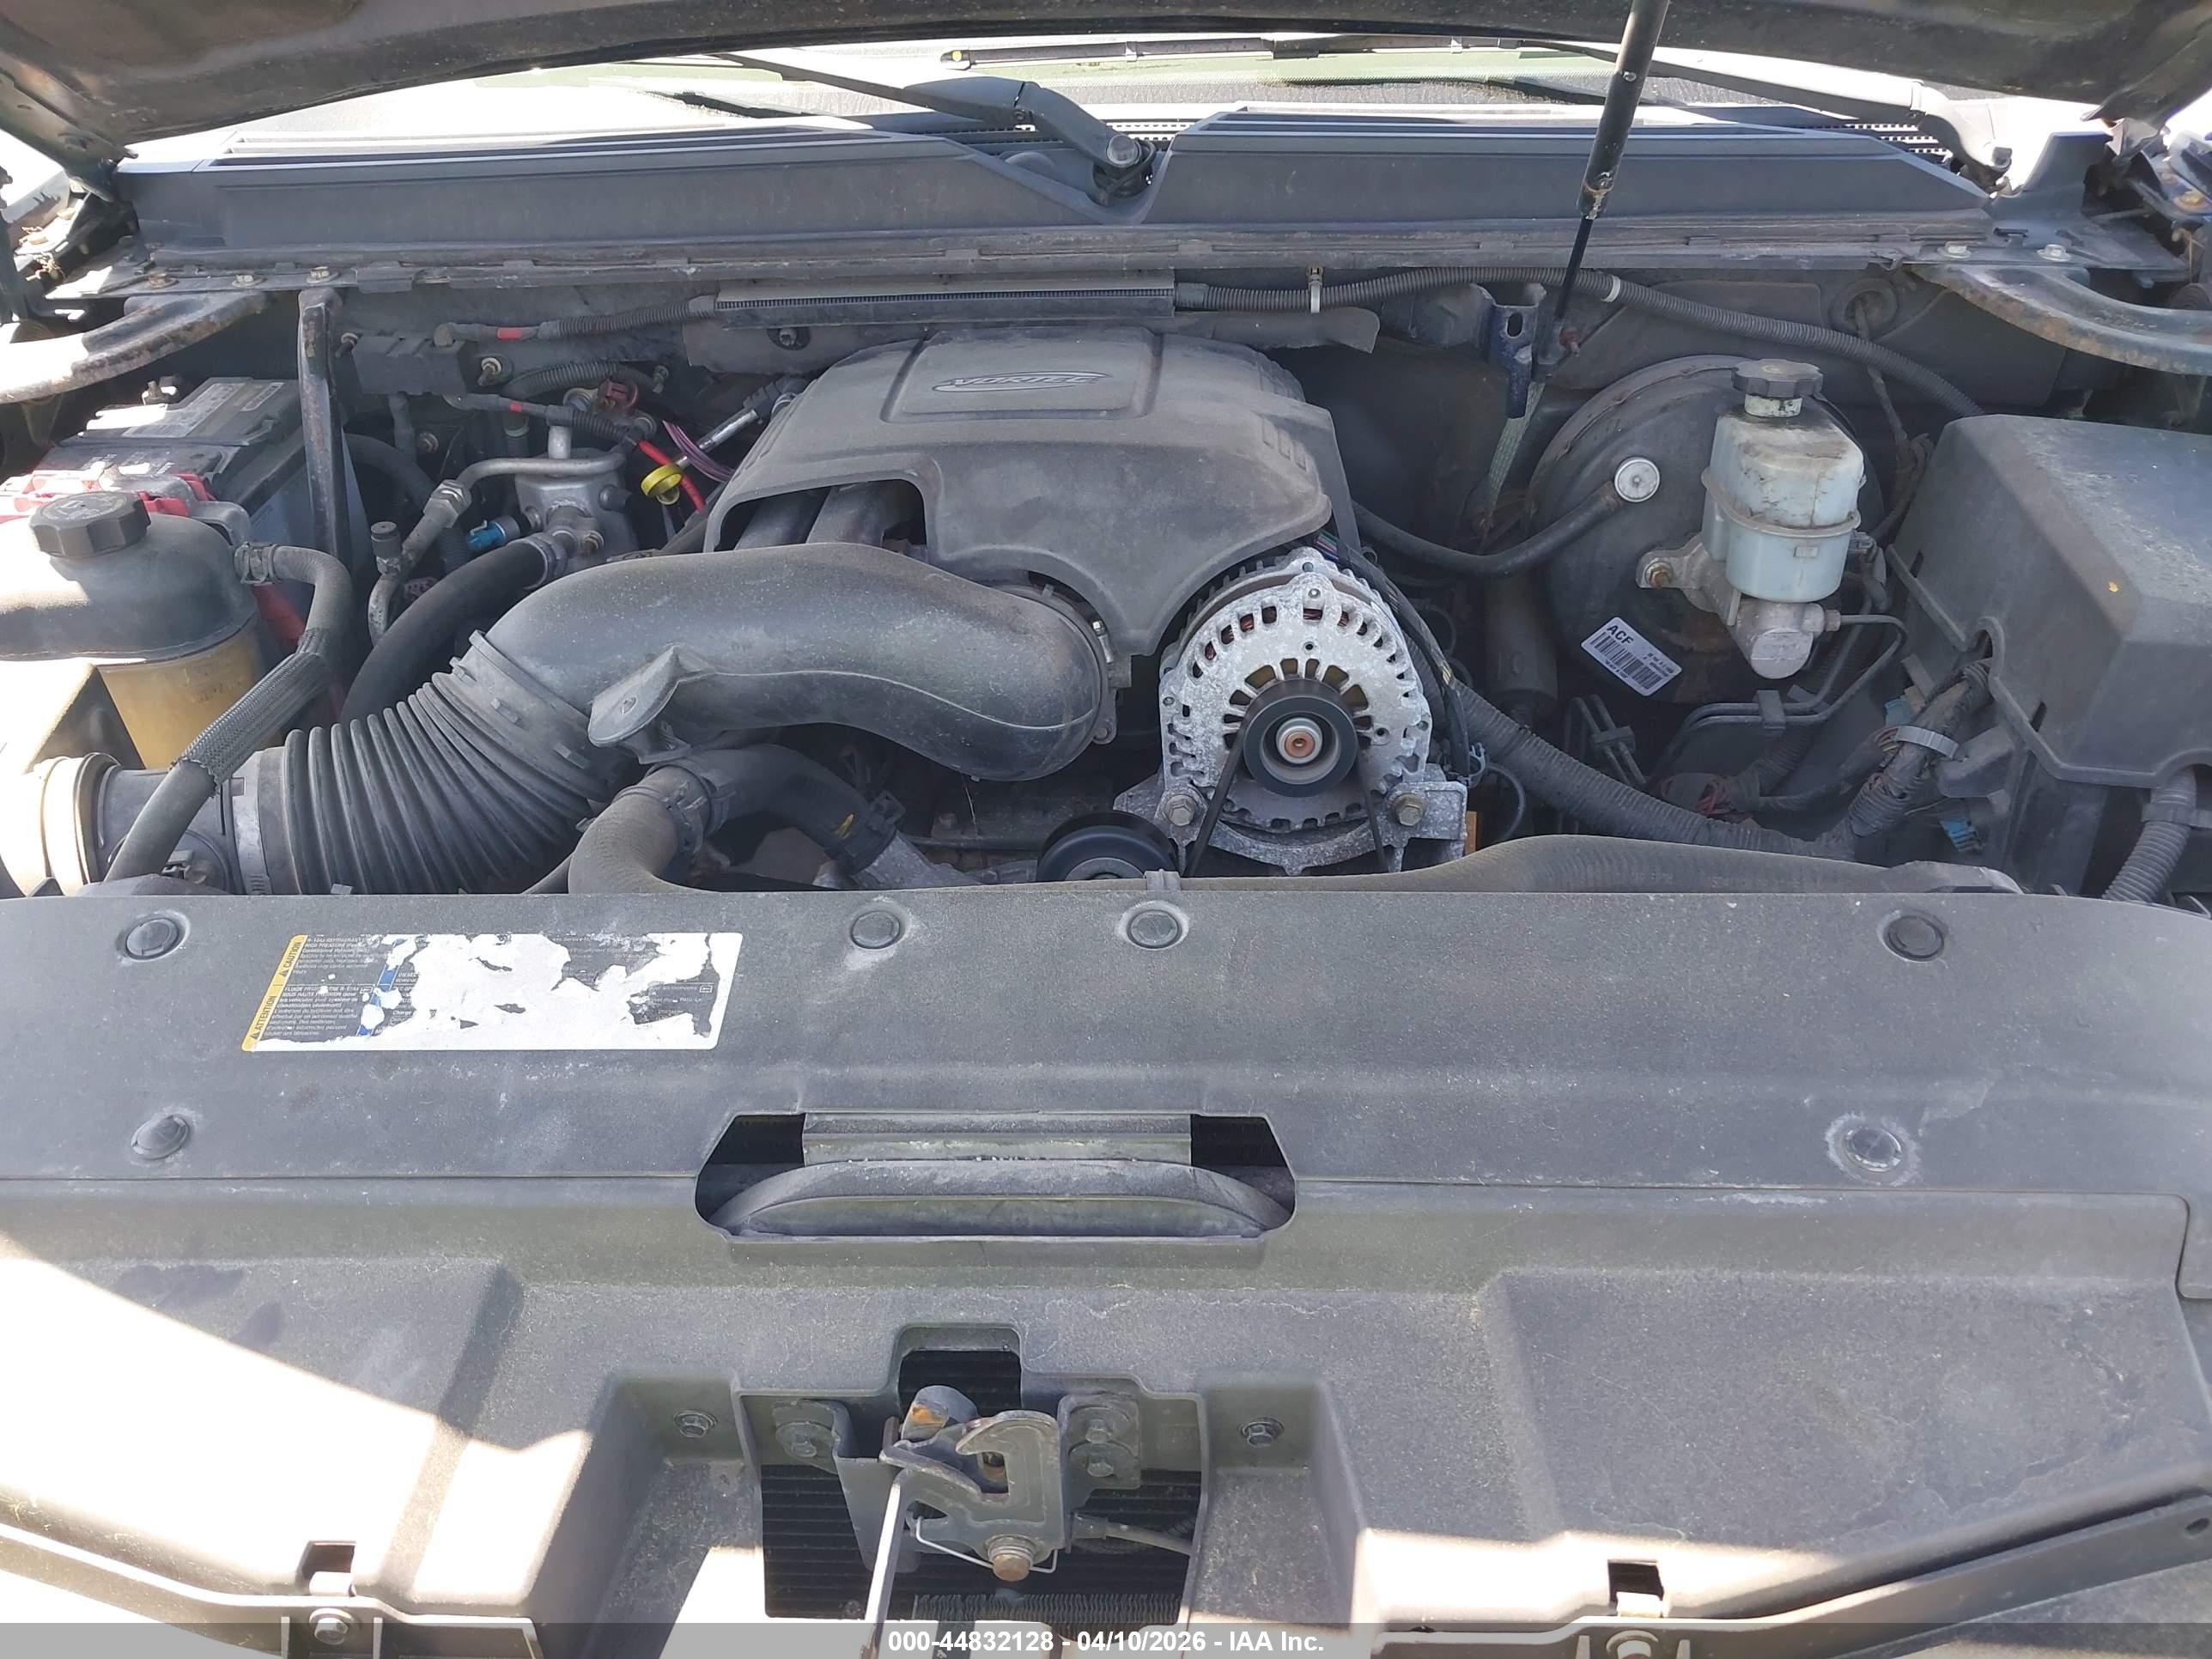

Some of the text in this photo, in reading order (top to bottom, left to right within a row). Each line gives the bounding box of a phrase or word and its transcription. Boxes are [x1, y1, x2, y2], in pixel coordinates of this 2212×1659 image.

[1607, 625, 1634, 644] ACF
[283, 942, 302, 968] CAUTION
[255, 996, 276, 1031] ATTENTION
